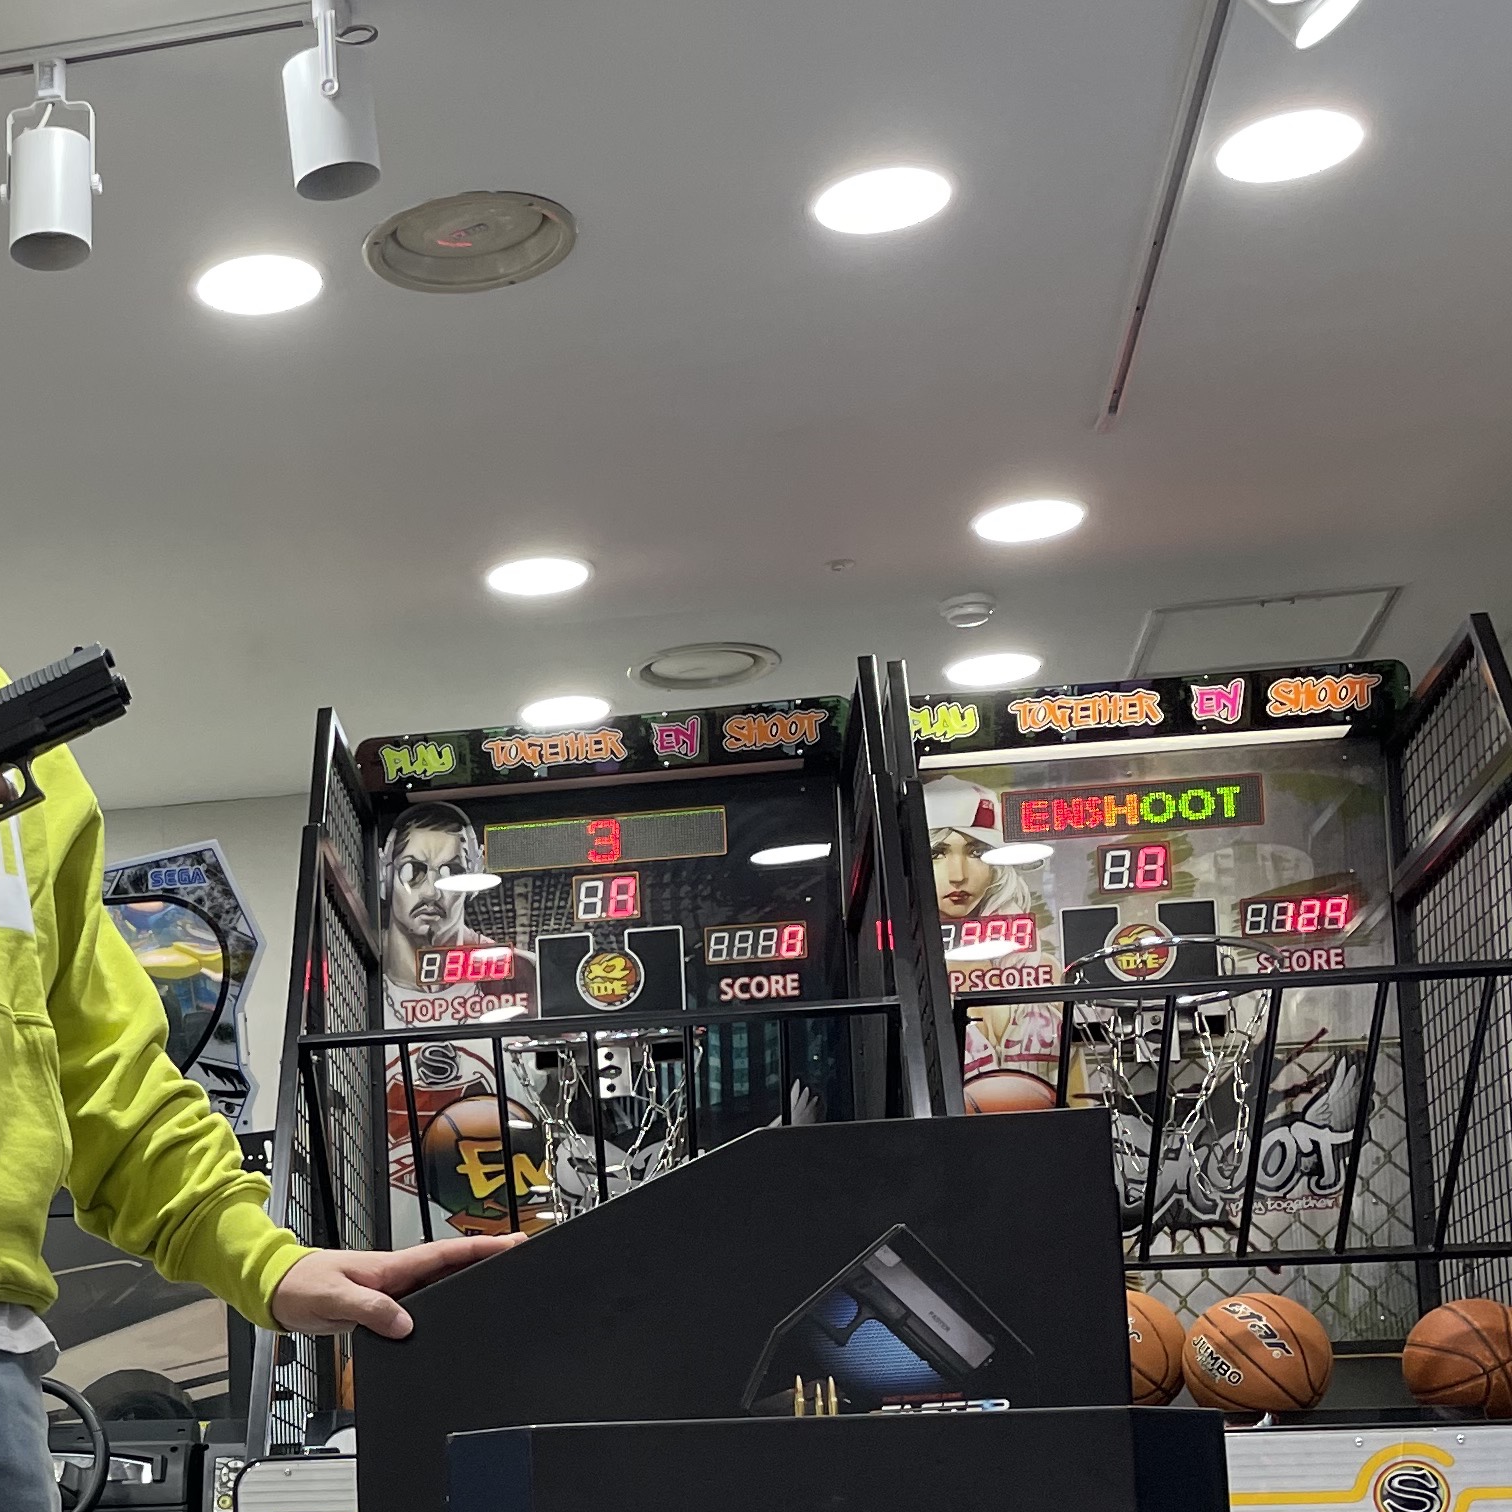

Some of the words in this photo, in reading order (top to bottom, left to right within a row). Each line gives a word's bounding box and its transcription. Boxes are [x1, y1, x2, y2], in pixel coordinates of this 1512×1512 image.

[1008, 689, 1165, 734] TOGETHER
[1190, 677, 1246, 724] EN
[1266, 673, 1382, 716] SHOOT
[380, 742, 456, 782] PLAY
[482, 727, 628, 770] TOGETHER
[654, 715, 700, 758] EN
[721, 709, 828, 752] SHOOT
[1020, 786, 1240, 833] ENSHOOT
[587, 819, 621, 864] 3
[150, 866, 207, 888] SEGA
[719, 973, 801, 1001] SCORE
[969, 965, 1054, 991] SCORE
[401, 999, 448, 1023] TOP
[1192, 1335, 1243, 1386] JUMBO
